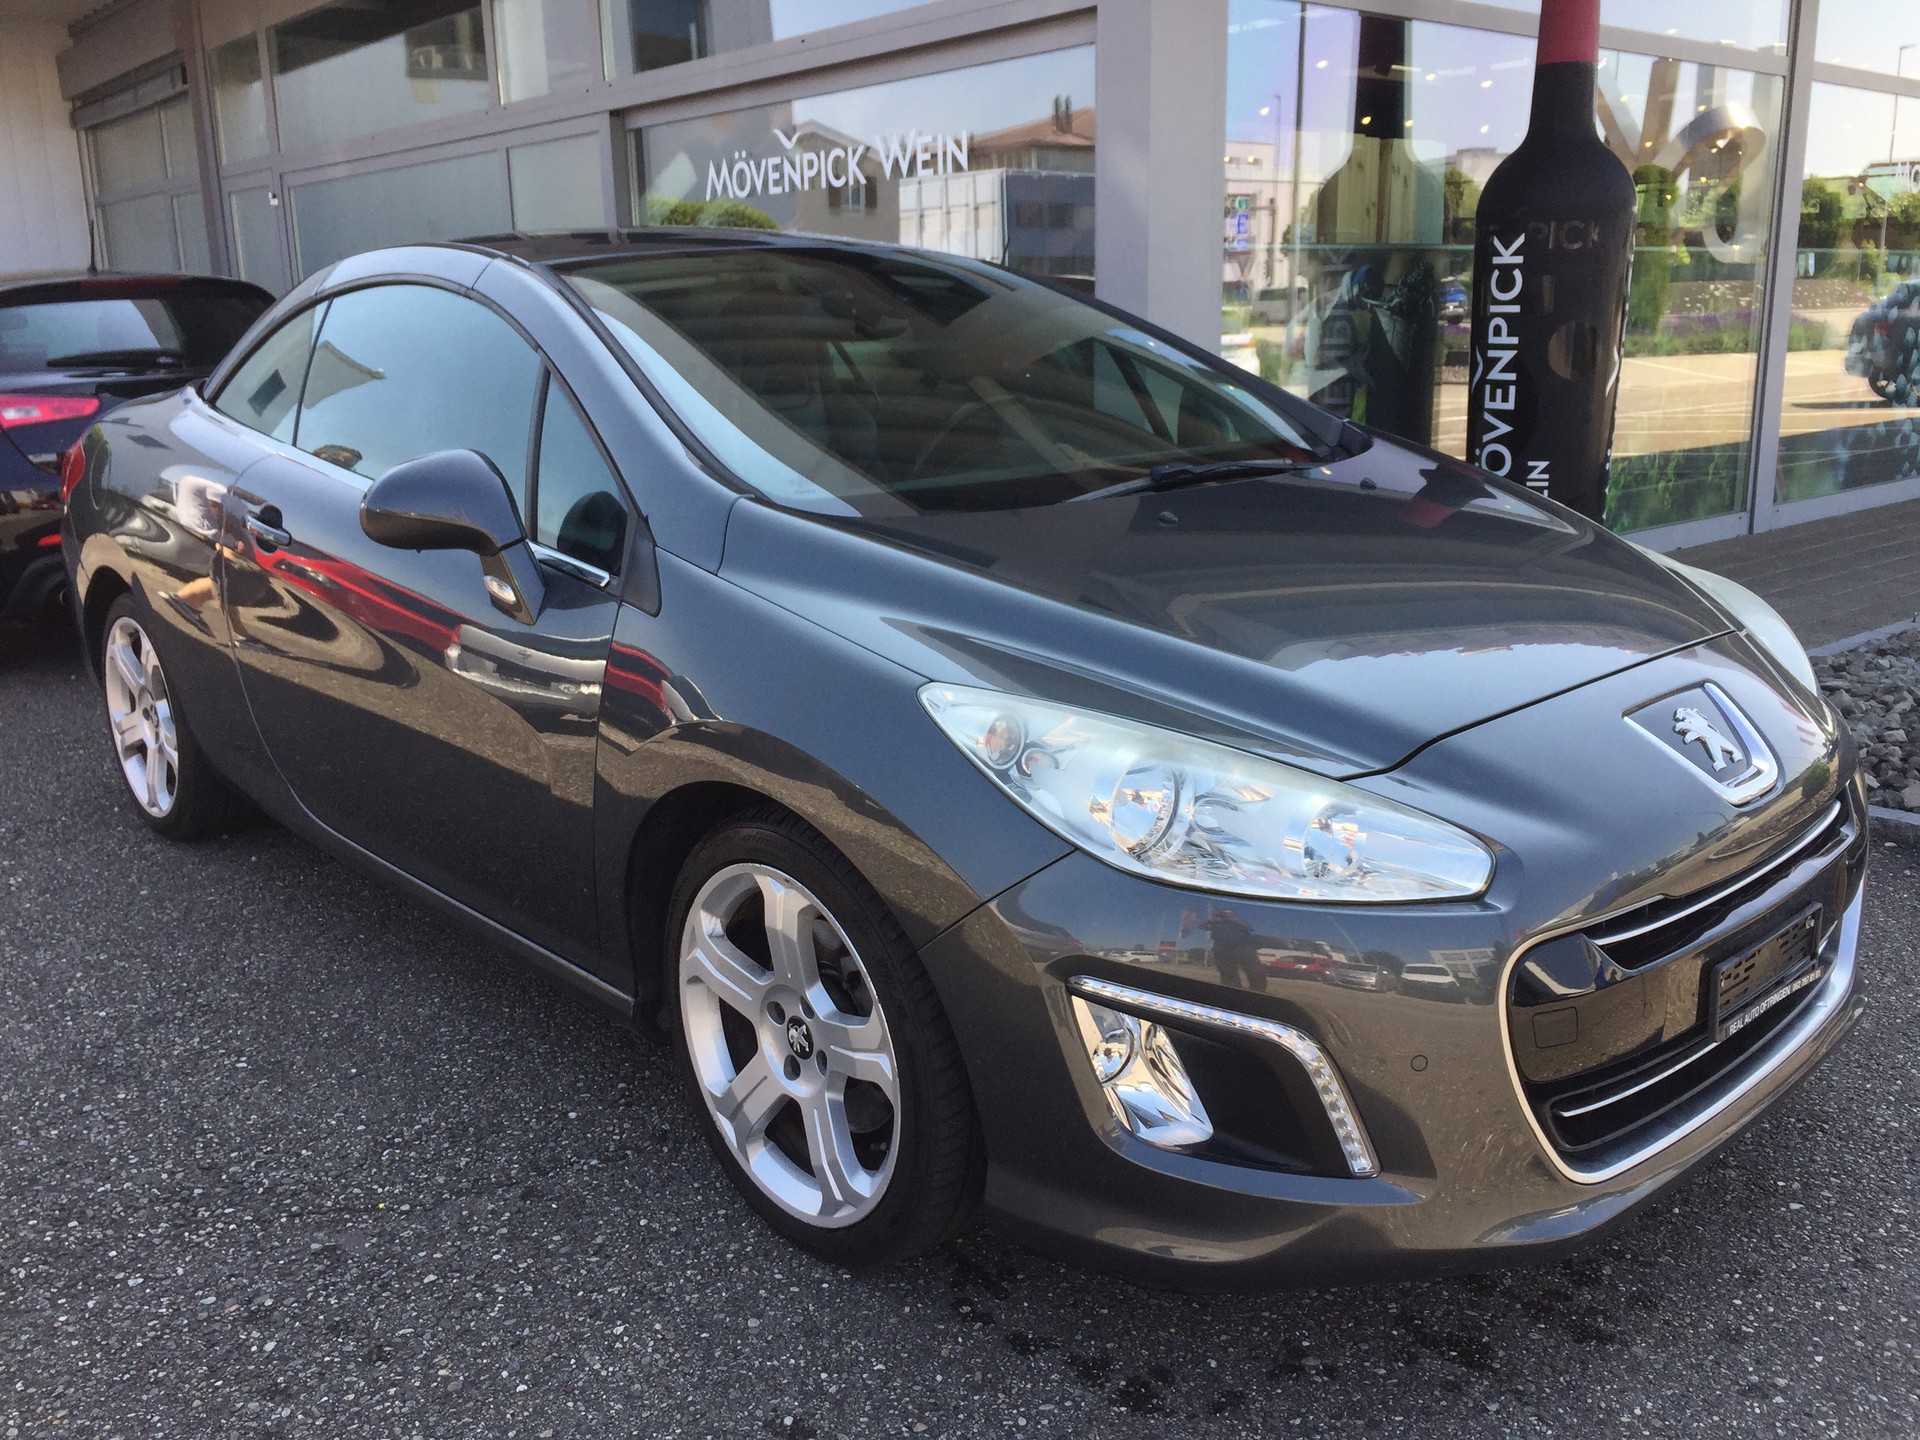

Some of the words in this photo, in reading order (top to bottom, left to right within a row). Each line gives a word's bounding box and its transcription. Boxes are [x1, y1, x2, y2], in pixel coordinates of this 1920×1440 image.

[705, 144, 868, 201] MÖVENPICK
[876, 129, 969, 180] WEIN
[1473, 232, 1526, 477] ÖVENPICK
[1744, 1006, 1760, 1025] AUTO
